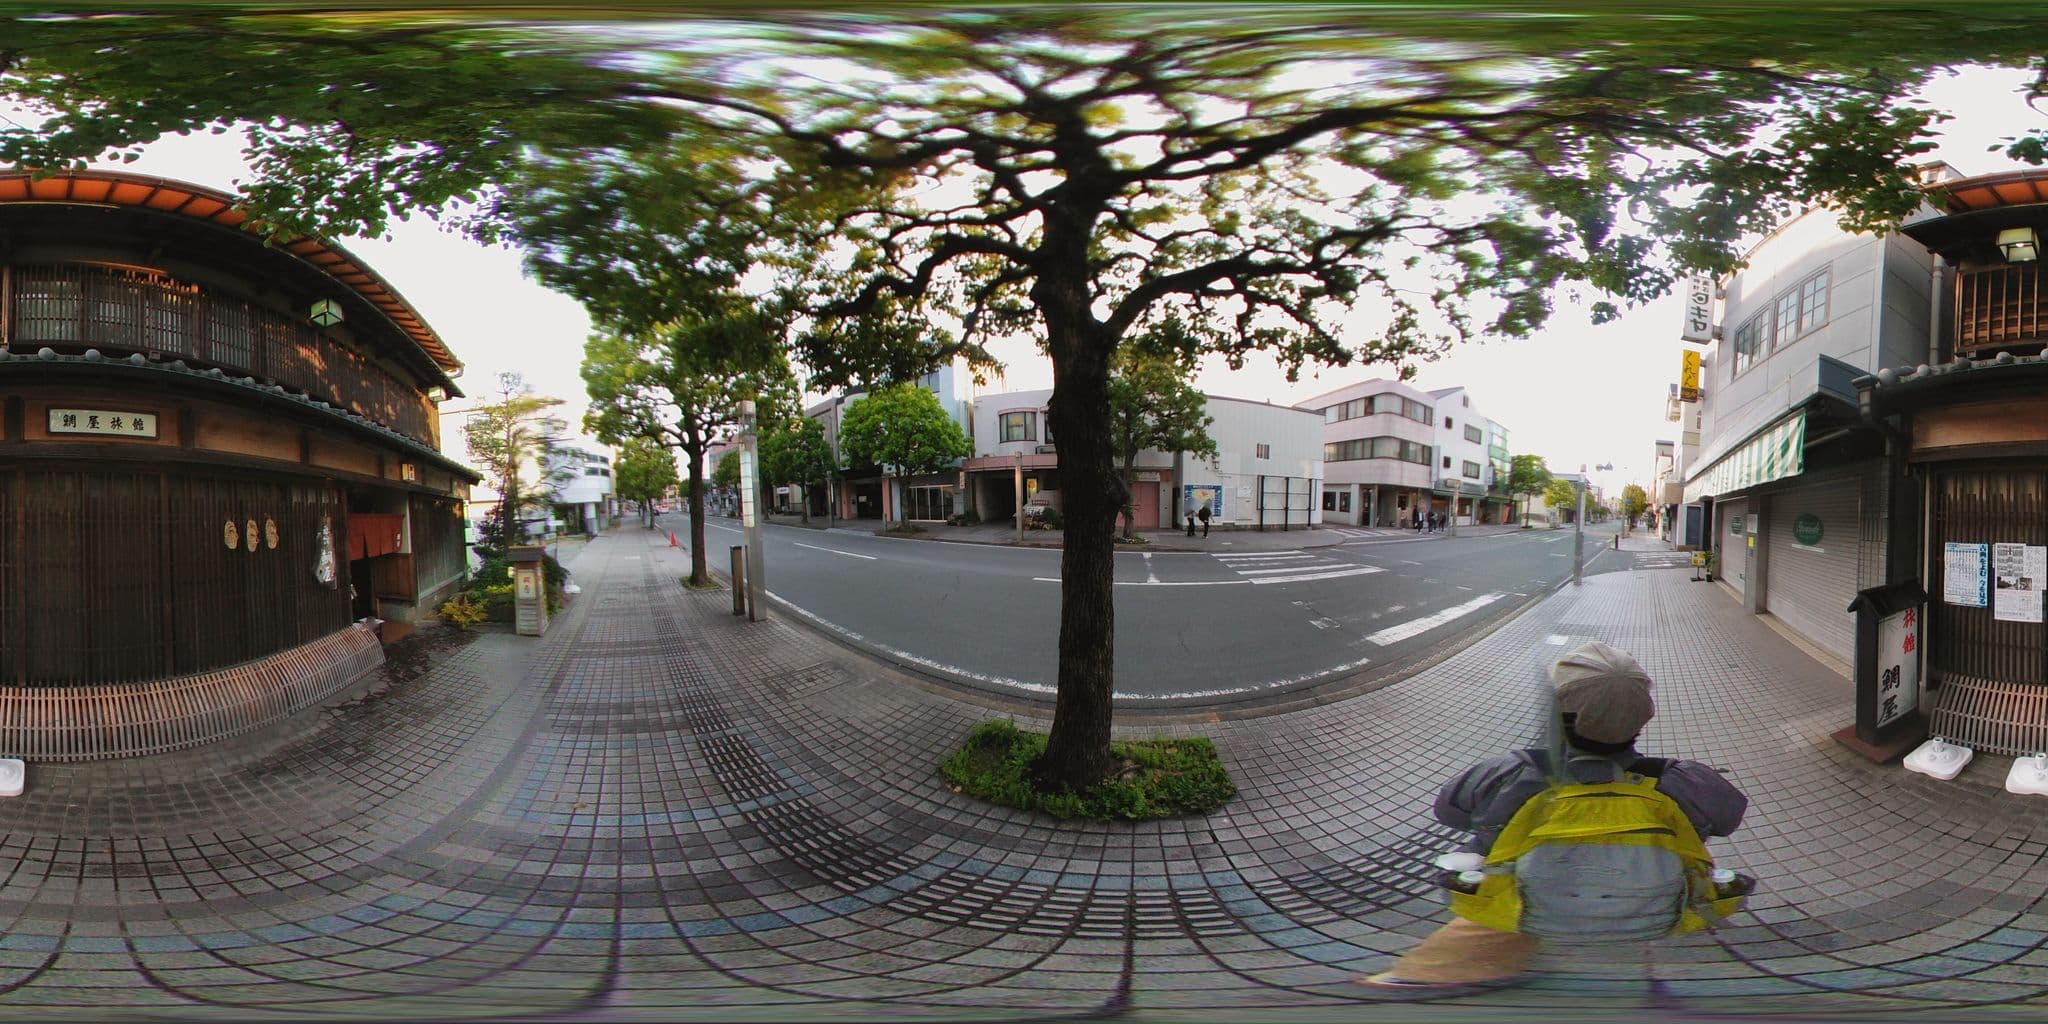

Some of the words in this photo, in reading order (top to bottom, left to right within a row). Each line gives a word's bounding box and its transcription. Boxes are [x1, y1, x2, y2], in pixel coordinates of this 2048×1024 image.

[63, 414, 144, 431] 鯛屋旅館
[1902, 608, 1916, 655] 旅館
[1877, 664, 1901, 724] 鯛屋
